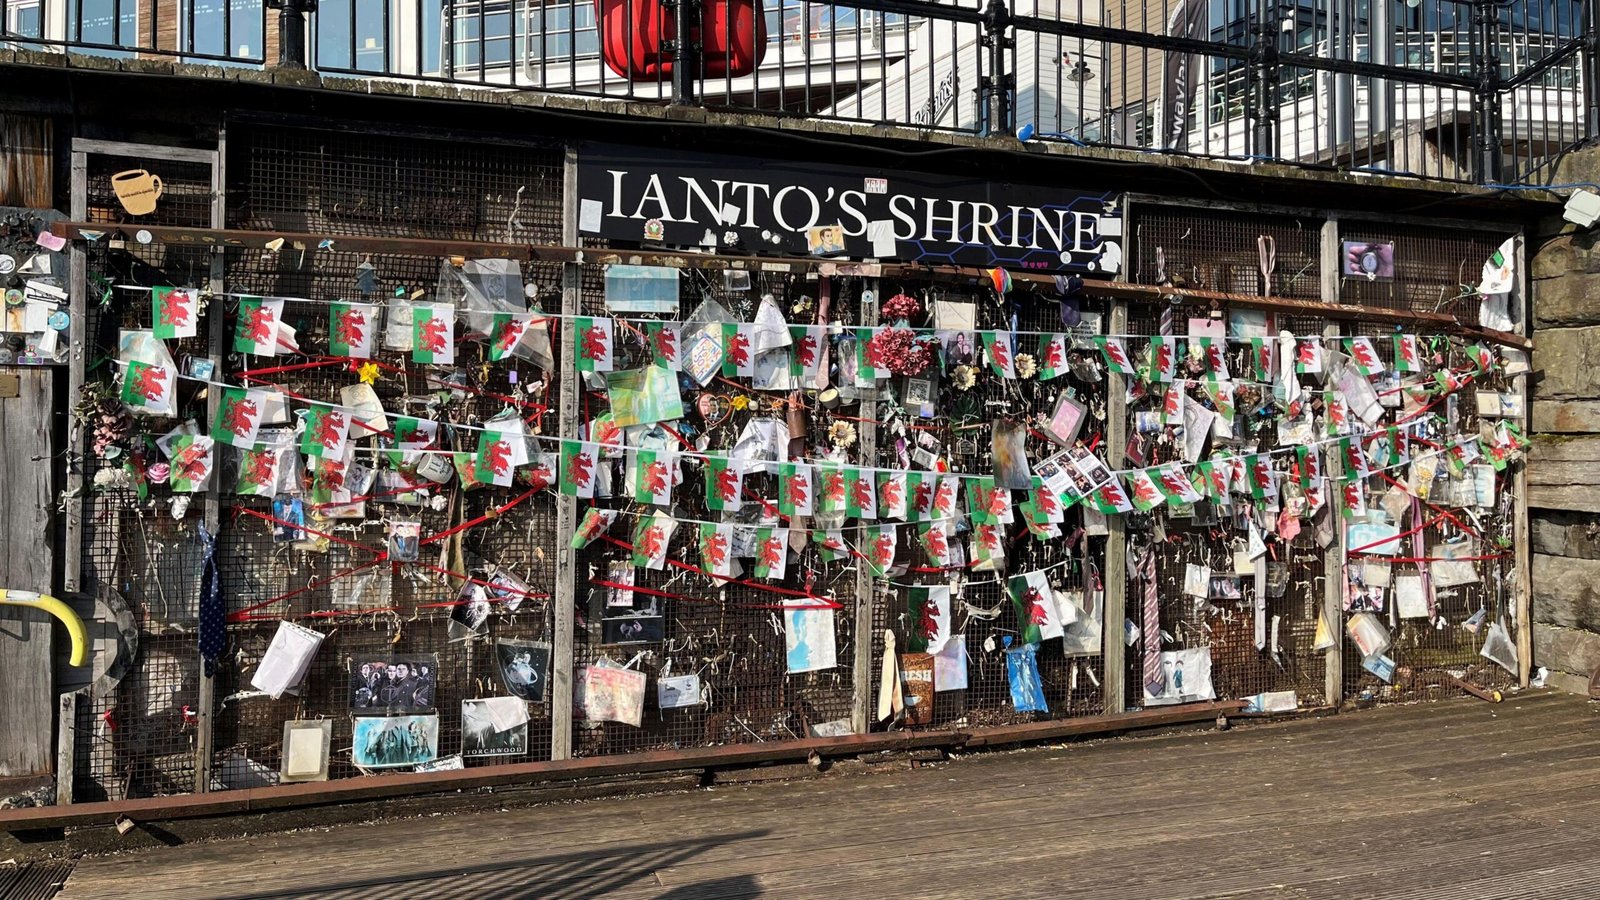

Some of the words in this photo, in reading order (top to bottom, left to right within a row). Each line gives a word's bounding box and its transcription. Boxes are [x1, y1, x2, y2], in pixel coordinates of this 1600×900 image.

[606, 169, 868, 237] IANTO'S
[889, 193, 1104, 255] SHRINE
[467, 747, 522, 755] TORCHWOOD
